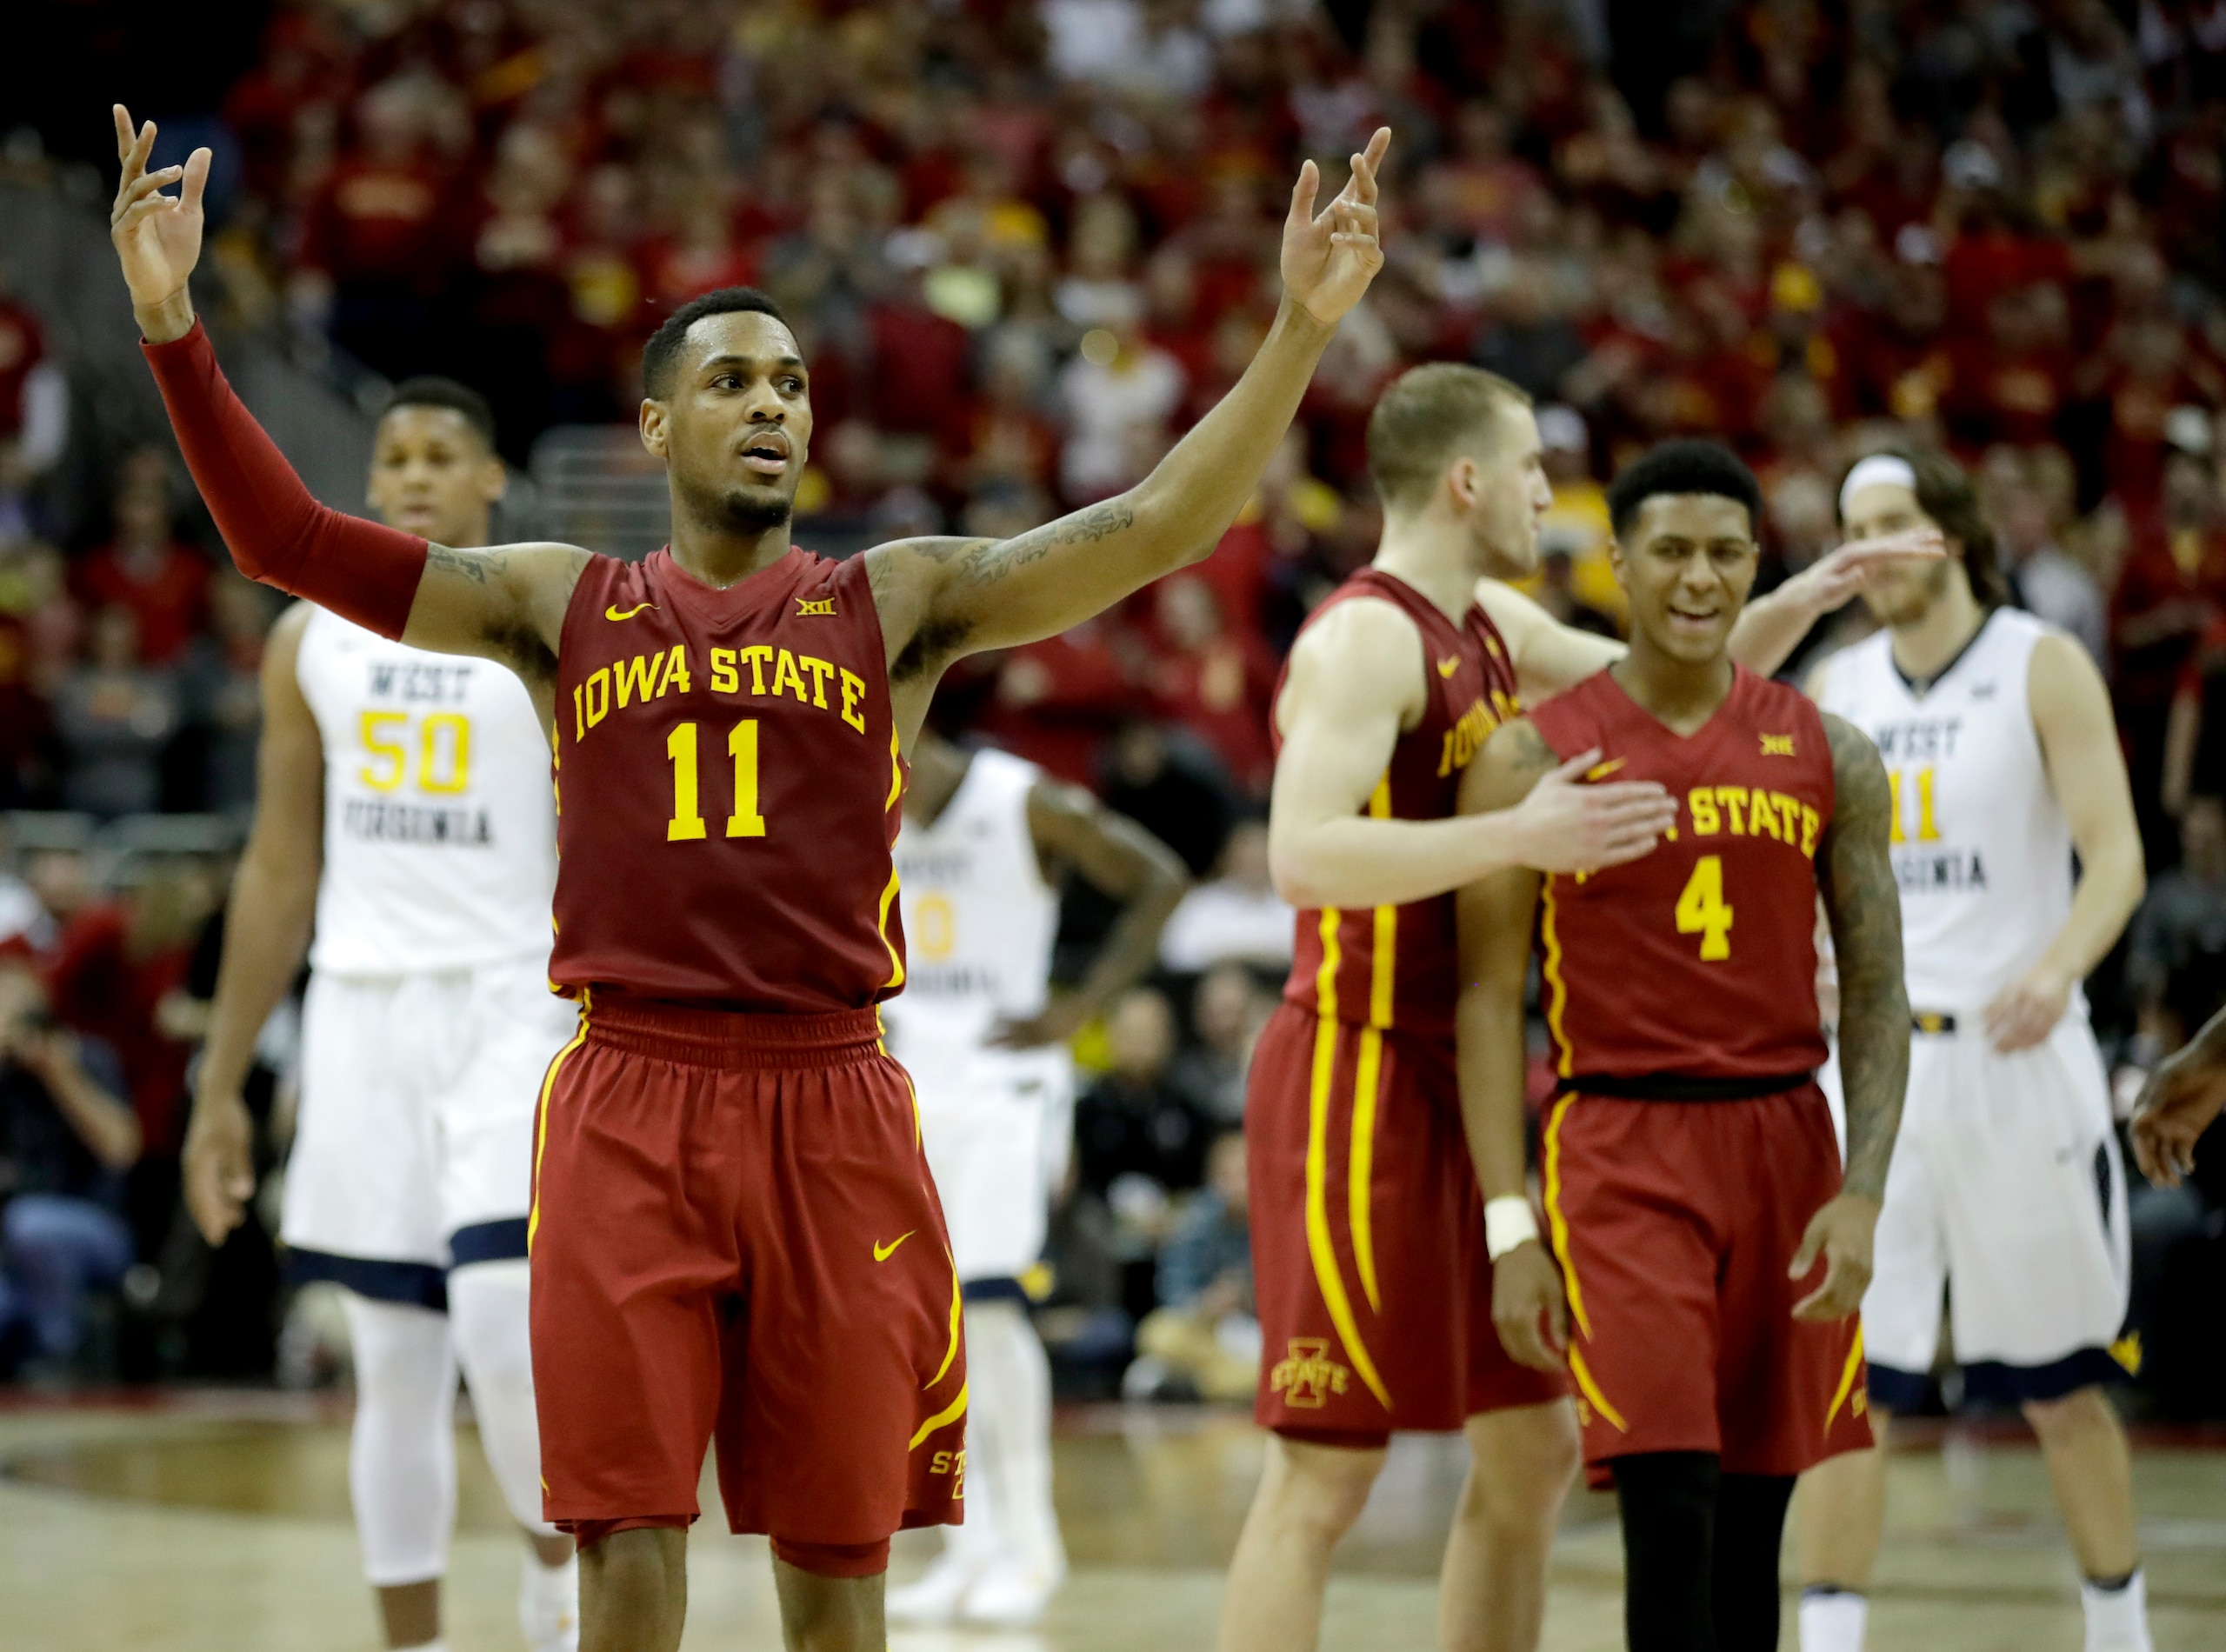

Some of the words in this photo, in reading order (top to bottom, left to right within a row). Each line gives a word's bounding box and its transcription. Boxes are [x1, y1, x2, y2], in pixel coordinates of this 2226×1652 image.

[367, 662, 474, 703] WEST
[572, 644, 691, 743] IOWA
[710, 644, 866, 736] STATE
[357, 710, 473, 796] 50
[1875, 718, 1962, 759] WEST
[666, 718, 766, 842] 11
[345, 796, 494, 849] VIRGINIA
[1688, 786, 1820, 861] STATE
[1675, 855, 1734, 961] 4
[1890, 849, 1988, 894] GINIA
